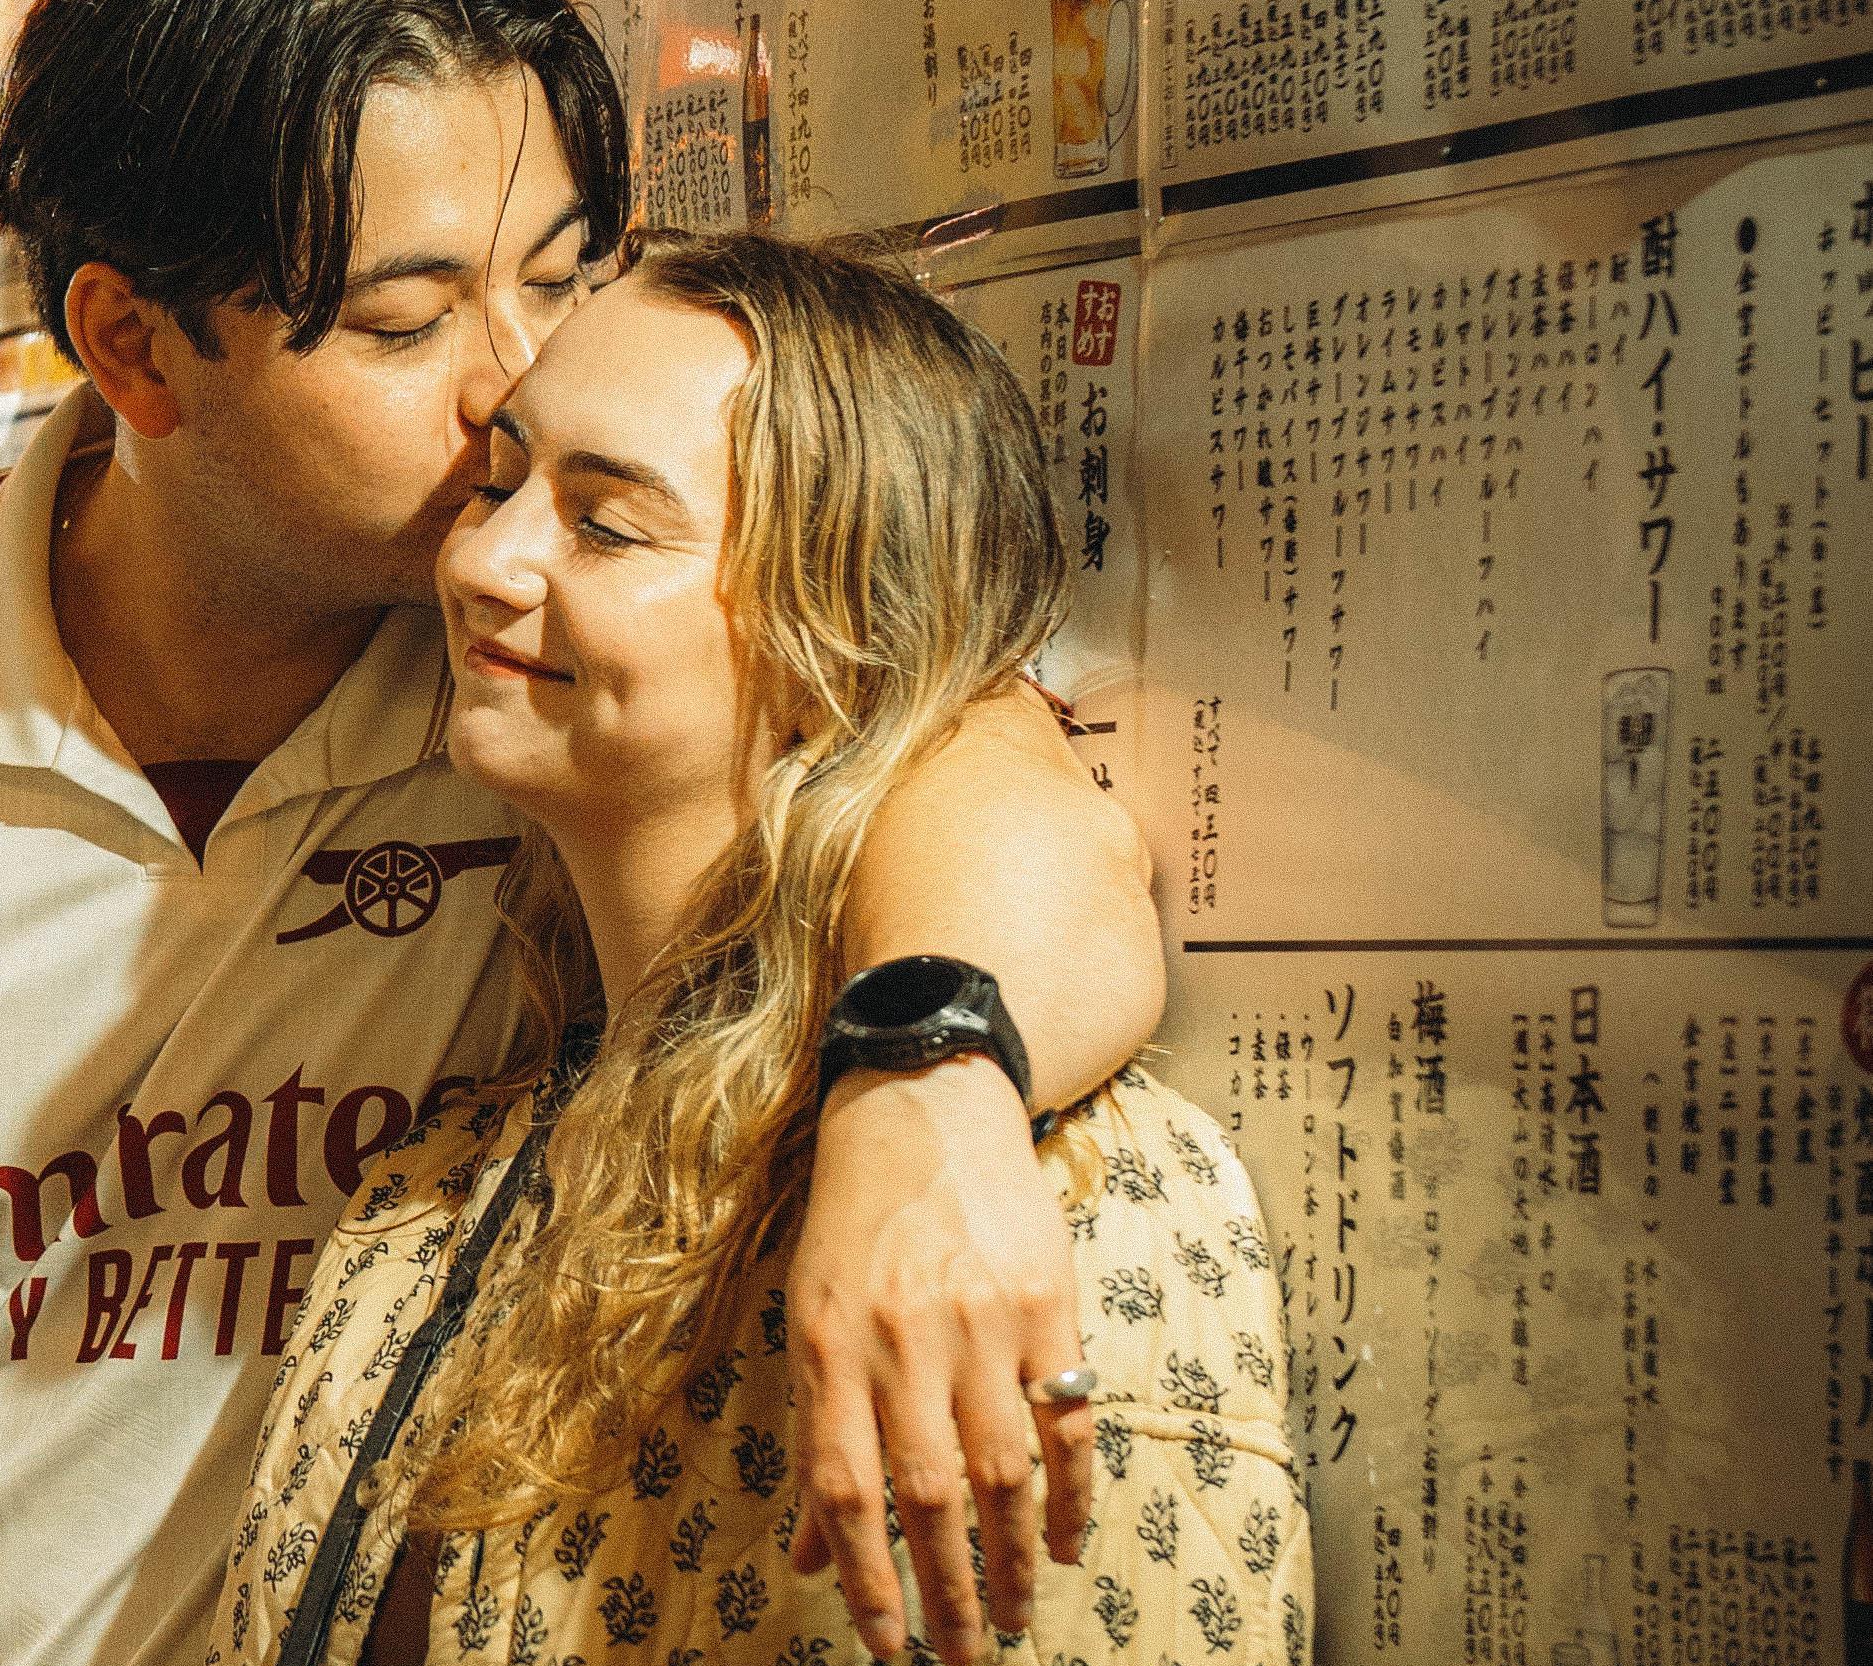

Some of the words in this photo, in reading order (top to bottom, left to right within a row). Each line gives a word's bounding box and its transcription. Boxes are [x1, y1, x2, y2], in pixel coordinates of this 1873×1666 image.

[1077, 381, 1111, 574] お刺身
[1354, 292, 1372, 555] オレンジサワー
[1379, 288, 1397, 514] ライムサワー
[1404, 286, 1422, 511] レモンサワー
[1453, 276, 1473, 465] トマトハイ
[1634, 206, 1680, 640] 酎ハイ・サワー
[1409, 979, 1450, 1114] 梅酒
[1564, 985, 1607, 1195] 日本酒
[76, 1239, 318, 1365] BETTE
[1322, 984, 1360, 1463] ソフトドリンク
